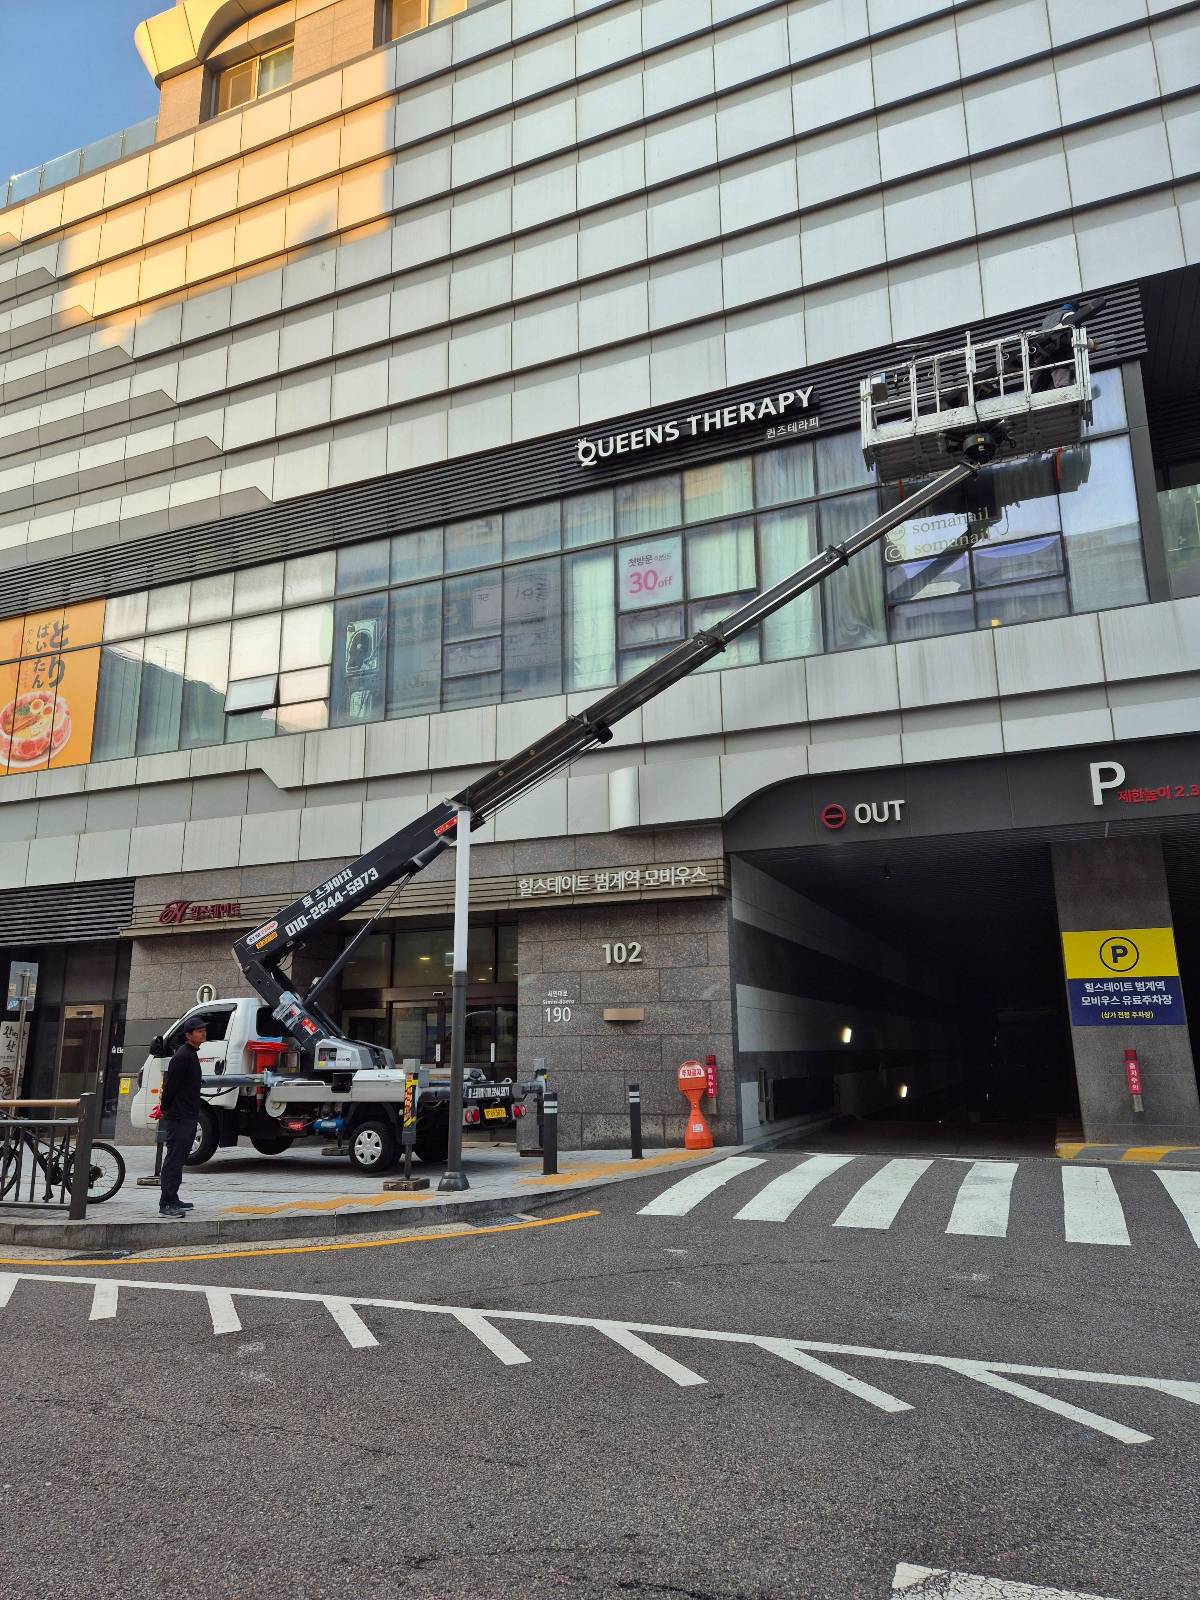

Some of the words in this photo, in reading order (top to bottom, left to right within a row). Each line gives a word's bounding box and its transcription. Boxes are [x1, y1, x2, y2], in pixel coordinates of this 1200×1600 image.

[576, 420, 680, 466] QUEENS
[687, 386, 814, 435] THERAPY
[766, 417, 819, 438] 퀸즈테라피
[912, 507, 989, 535] somanail
[629, 570, 658, 594] 30
[658, 576, 672, 588] off
[1090, 761, 1126, 806] P
[1118, 785, 1171, 804] 제한높이
[854, 800, 905, 824] OUT
[315, 868, 353, 900] 스카이차
[518, 874, 591, 897] 힐스테이트
[595, 870, 640, 892] 범계역
[644, 866, 709, 886] 모비우스
[284, 867, 379, 937] 010-2244-5973
[602, 941, 643, 964] 102
[1111, 945, 1128, 963] P
[1084, 982, 1134, 993] 힐스테이트
[1135, 980, 1165, 993] 범계역
[1081, 997, 1121, 1007] 모비우스
[1122, 995, 1173, 1006] 유료주차장
[545, 1006, 572, 1023] 190
